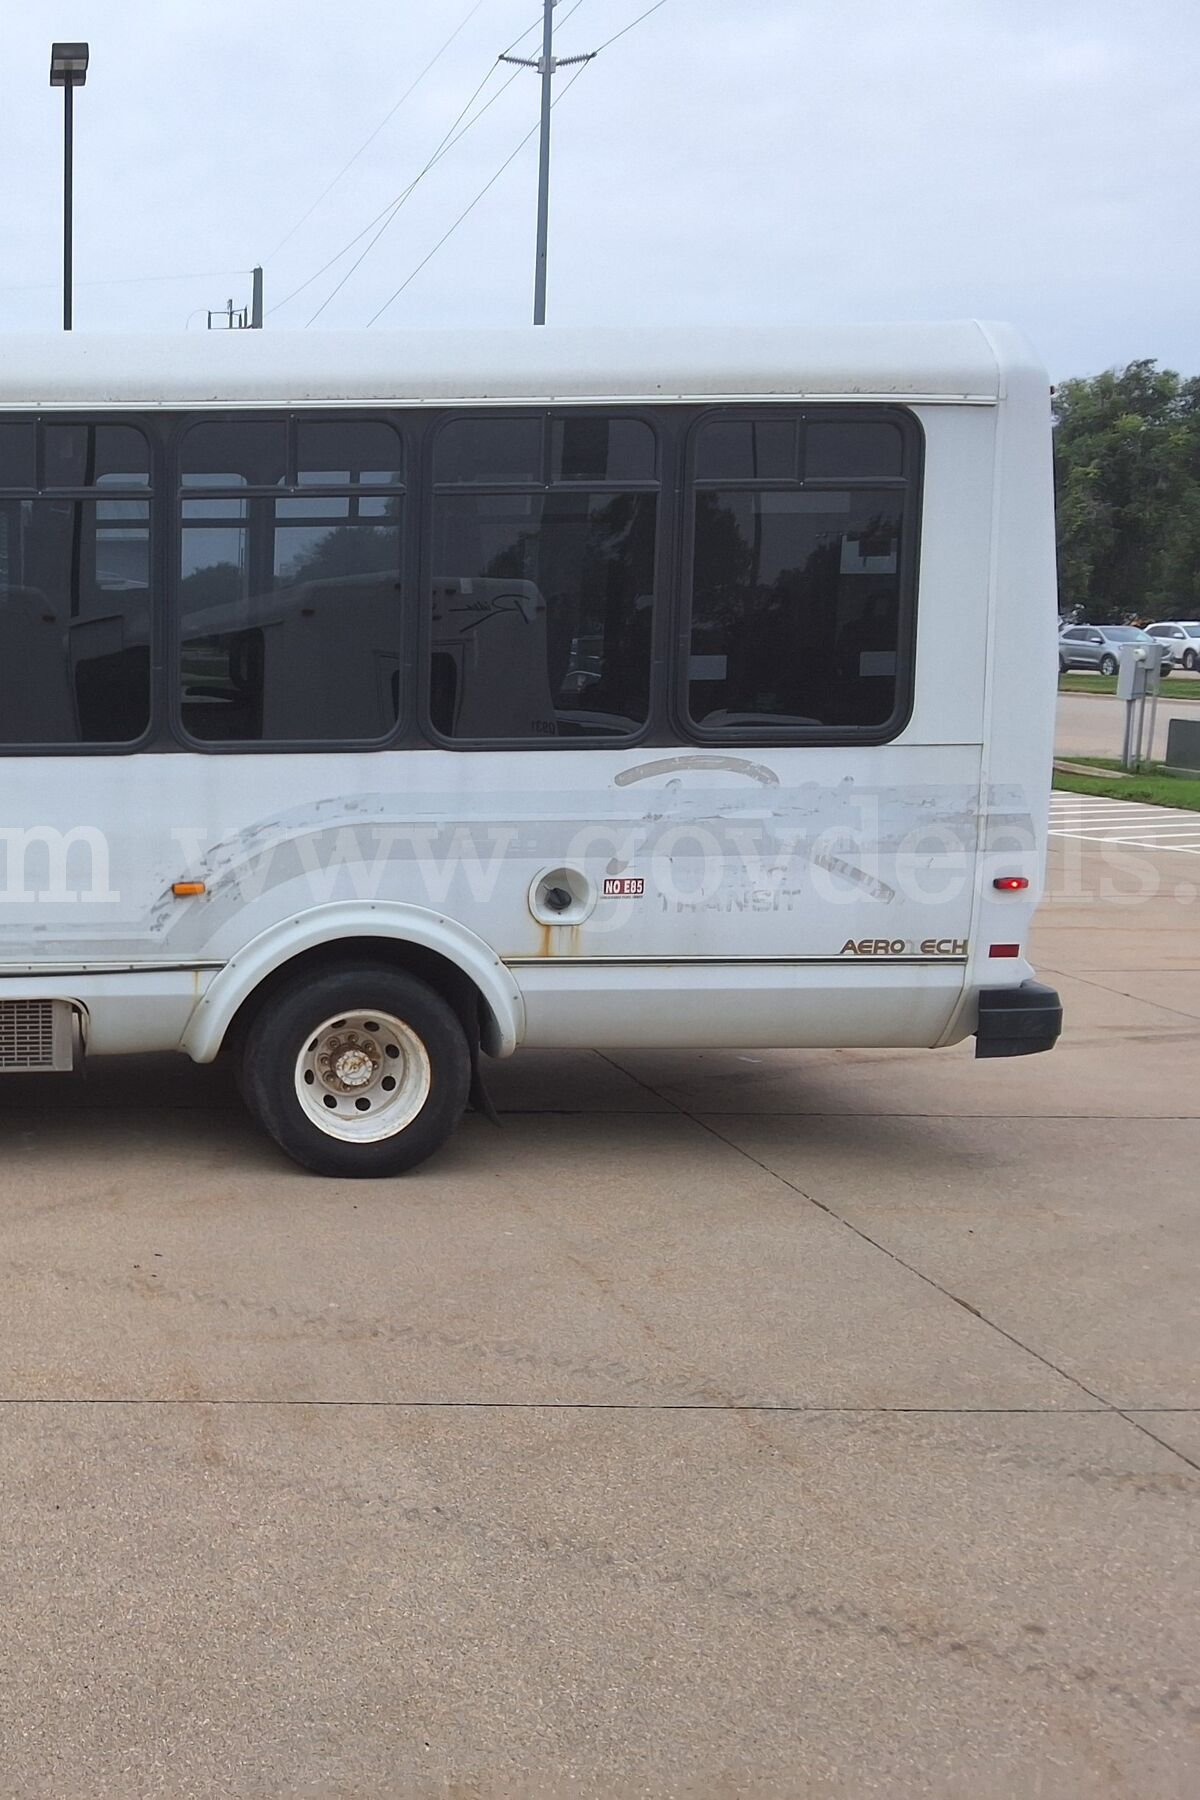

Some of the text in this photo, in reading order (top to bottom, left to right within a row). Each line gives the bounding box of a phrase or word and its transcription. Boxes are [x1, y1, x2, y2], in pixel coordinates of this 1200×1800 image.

[605, 880, 643, 894] NO E85
[840, 939, 968, 955] AEROECH
